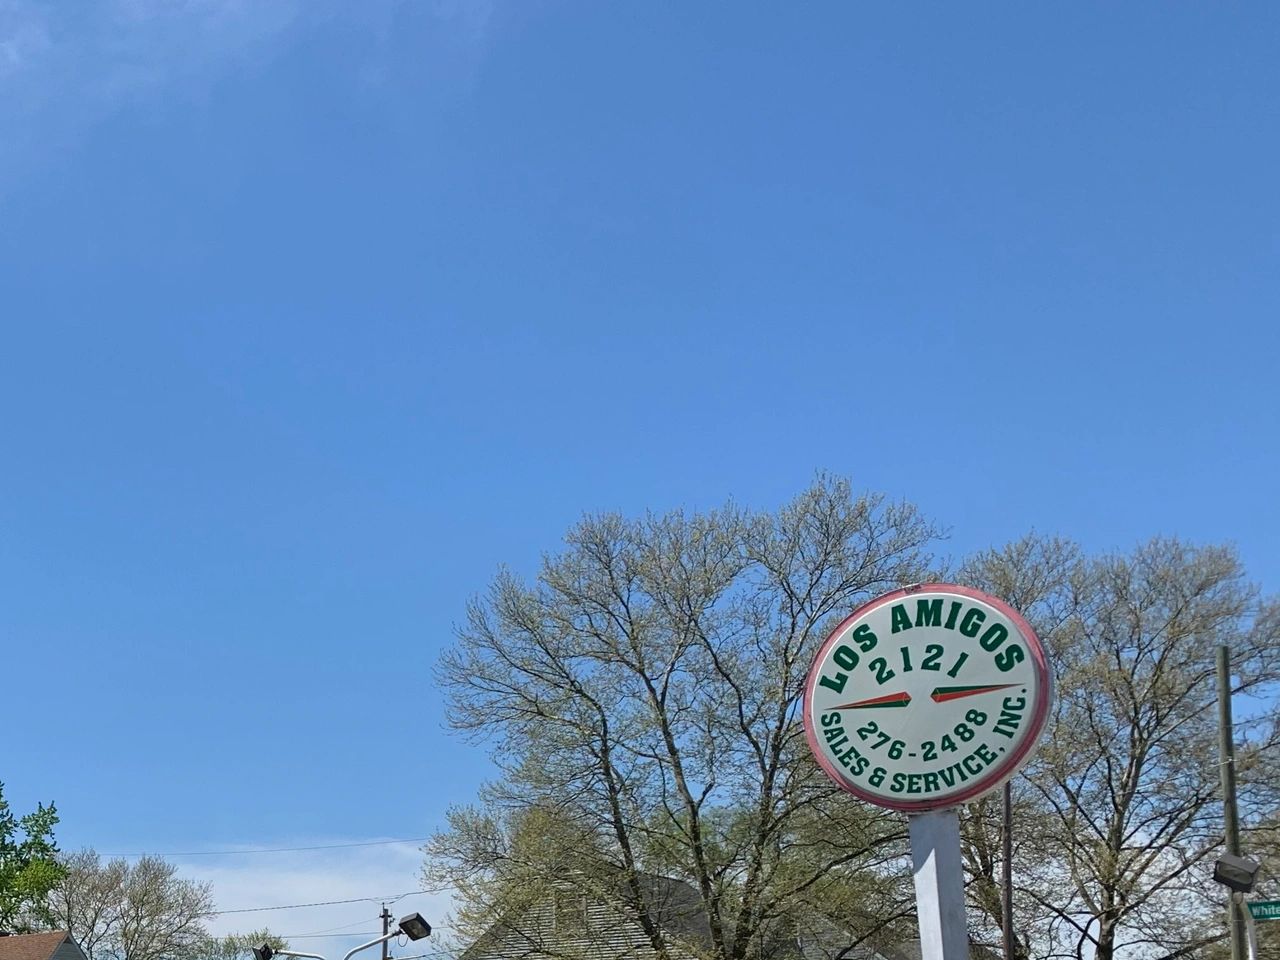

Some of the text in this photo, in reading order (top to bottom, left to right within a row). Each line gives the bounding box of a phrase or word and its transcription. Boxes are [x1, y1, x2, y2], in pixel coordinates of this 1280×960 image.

[819, 599, 1025, 695] LOS AMIGOS
[868, 644, 969, 686] 2121
[821, 687, 1027, 794] SALES & SERVICE, INC.
[856, 708, 988, 762] 276-2488
